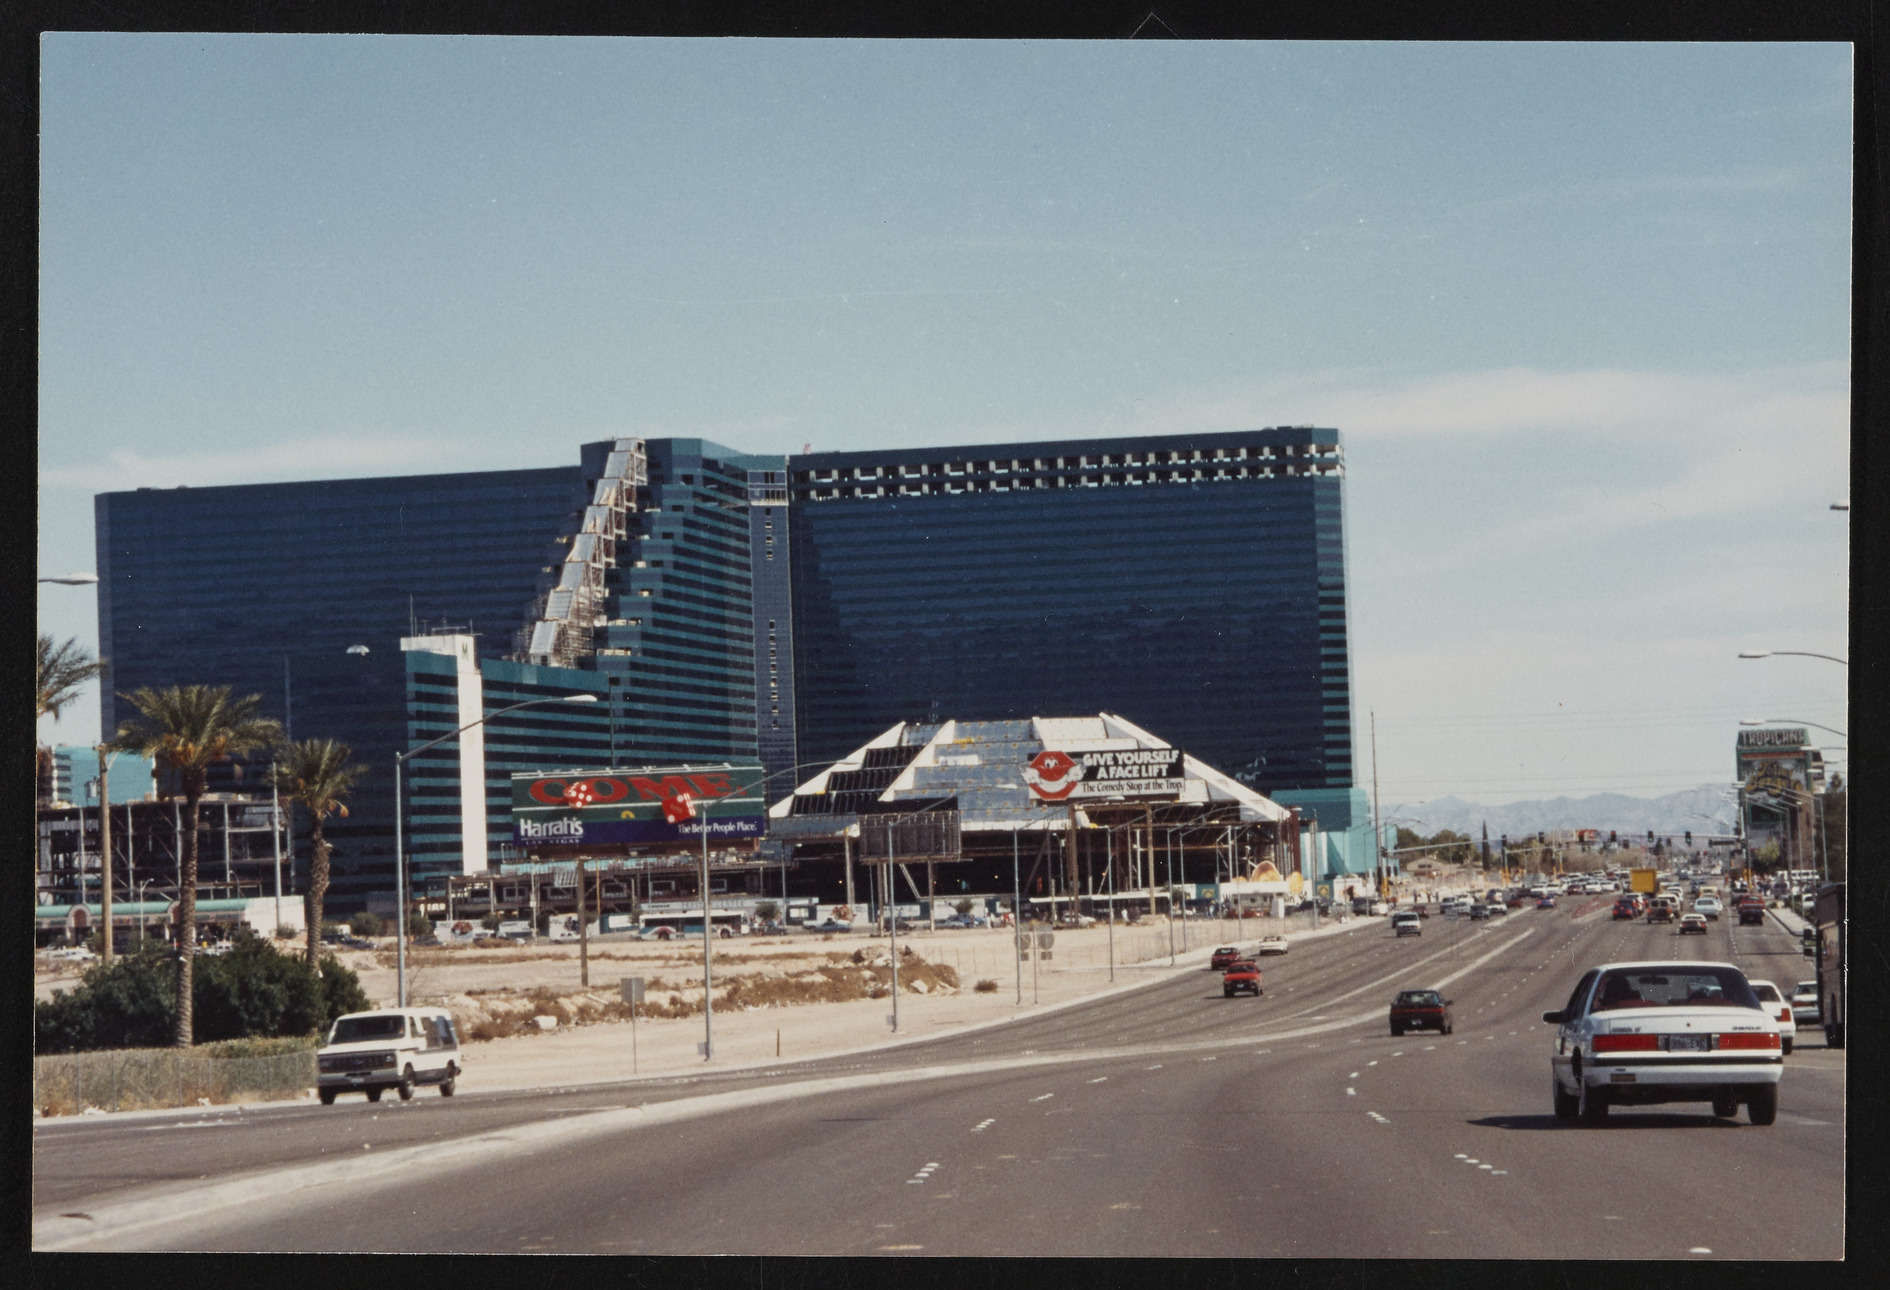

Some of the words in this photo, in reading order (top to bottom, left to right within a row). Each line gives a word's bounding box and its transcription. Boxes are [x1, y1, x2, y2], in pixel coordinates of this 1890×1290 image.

[1083, 753, 1114, 766] GIVE
[1115, 750, 1179, 765] YOURSELF
[1096, 766, 1108, 779] A
[1109, 765, 1140, 779] FACE
[1141, 764, 1168, 777] LIFT
[1083, 783, 1095, 792] The
[1096, 782, 1124, 793] Comedy
[1126, 782, 1143, 793] Stop
[1144, 782, 1151, 790] at
[1151, 781, 1163, 790] the
[520, 816, 584, 837] Harrah's
[678, 824, 691, 833] The
[691, 823, 712, 833] Beter
[713, 822, 736, 835] People
